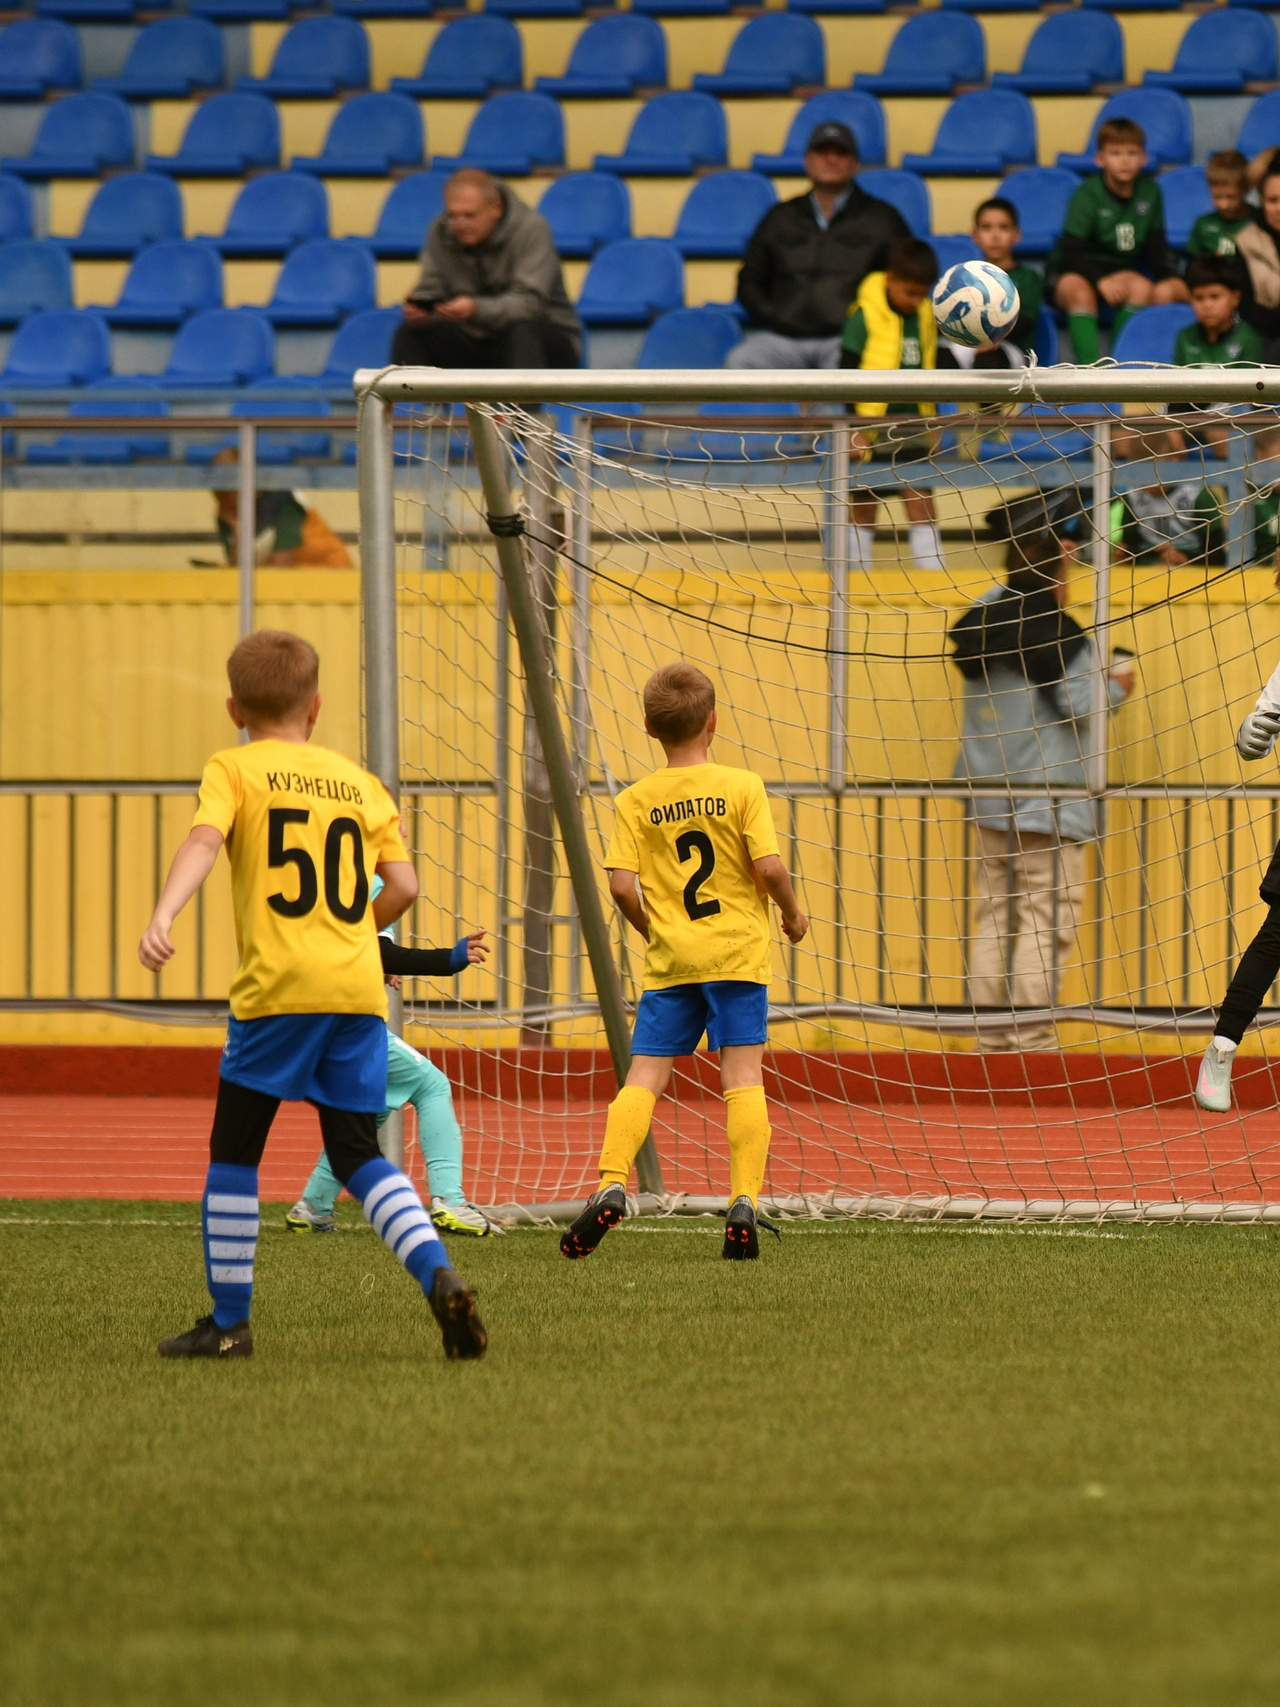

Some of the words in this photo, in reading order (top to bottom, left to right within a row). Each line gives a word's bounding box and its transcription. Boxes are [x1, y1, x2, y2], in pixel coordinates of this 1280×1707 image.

[266, 771, 364, 806] КУЗНЕЦОВ
[650, 796, 727, 826] ФИЛАТОВ
[266, 808, 369, 925] 50
[675, 830, 722, 922] 2
